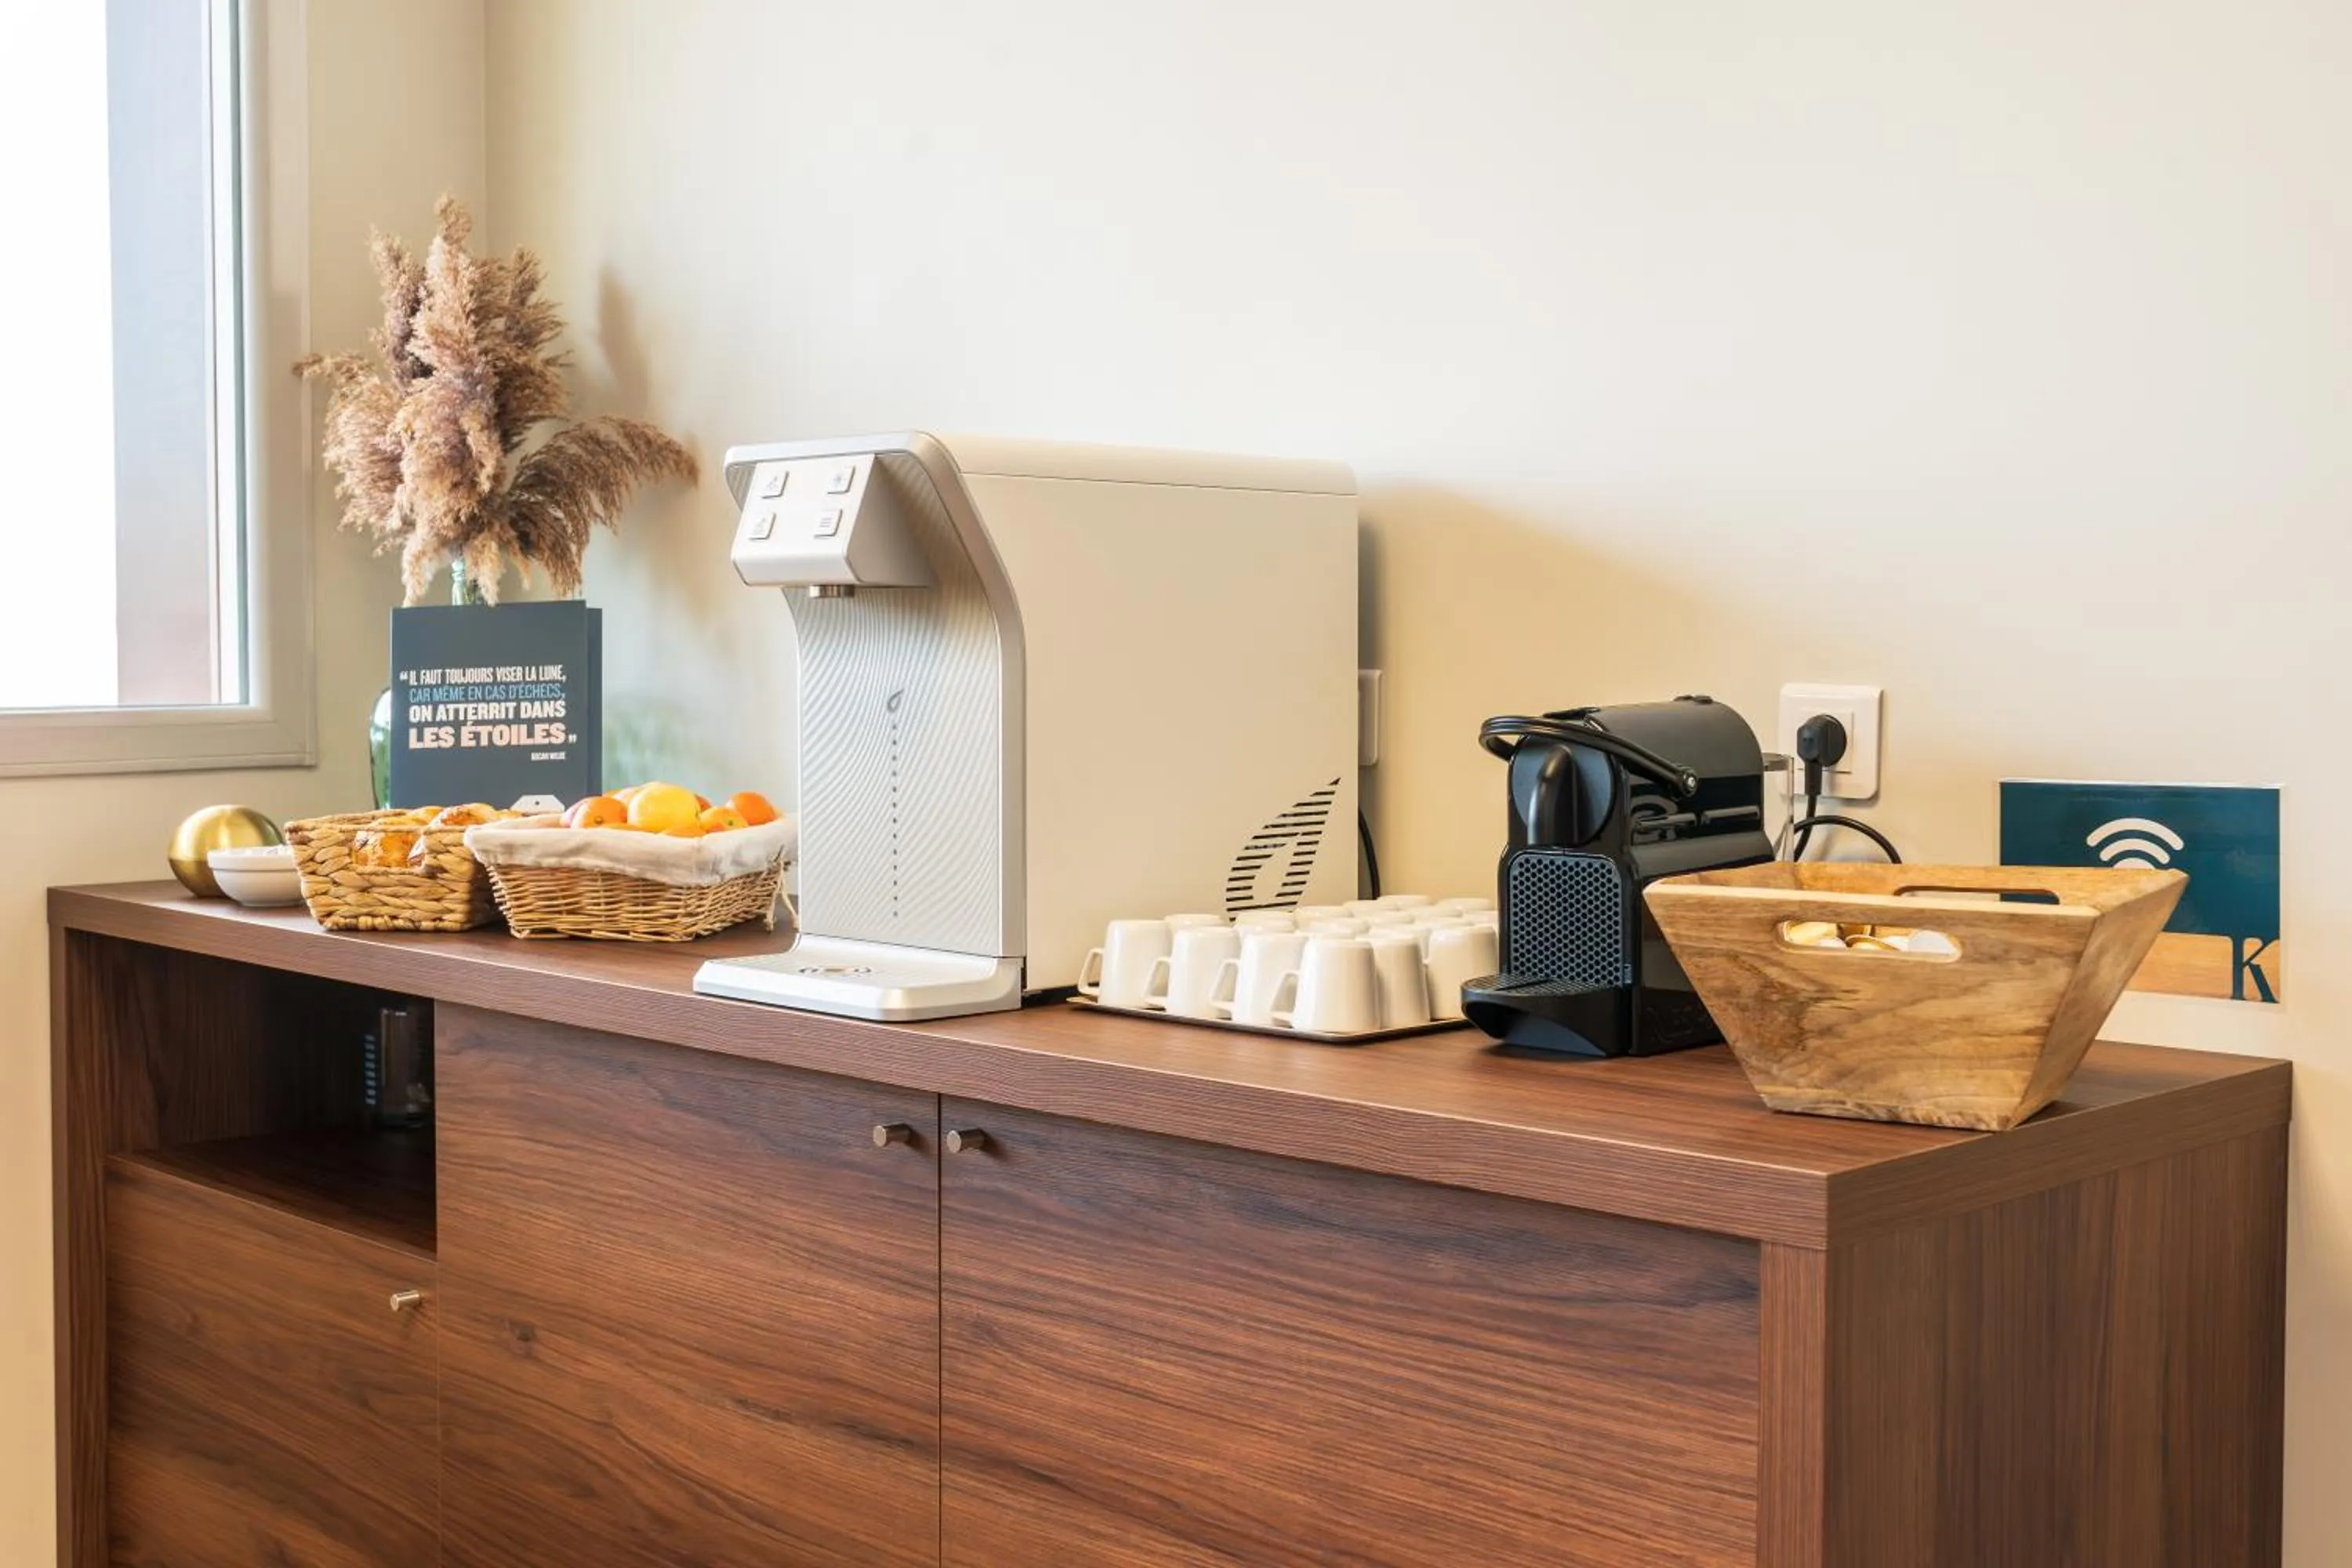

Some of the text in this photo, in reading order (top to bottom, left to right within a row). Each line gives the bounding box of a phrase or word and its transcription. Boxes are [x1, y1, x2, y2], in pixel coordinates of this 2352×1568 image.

[419, 668, 443, 685] FAUT
[445, 667, 494, 684] TOUJOURS
[495, 666, 523, 682] VISER
[524, 666, 537, 681] LA
[539, 664, 567, 683] LUNE,
[409, 688, 431, 703] CAR
[432, 684, 466, 702] MÊME
[467, 685, 482, 701] EN
[485, 684, 506, 700] CAS
[408, 699, 566, 723] ON ATTERRIT DANS
[408, 725, 456, 750] LES
